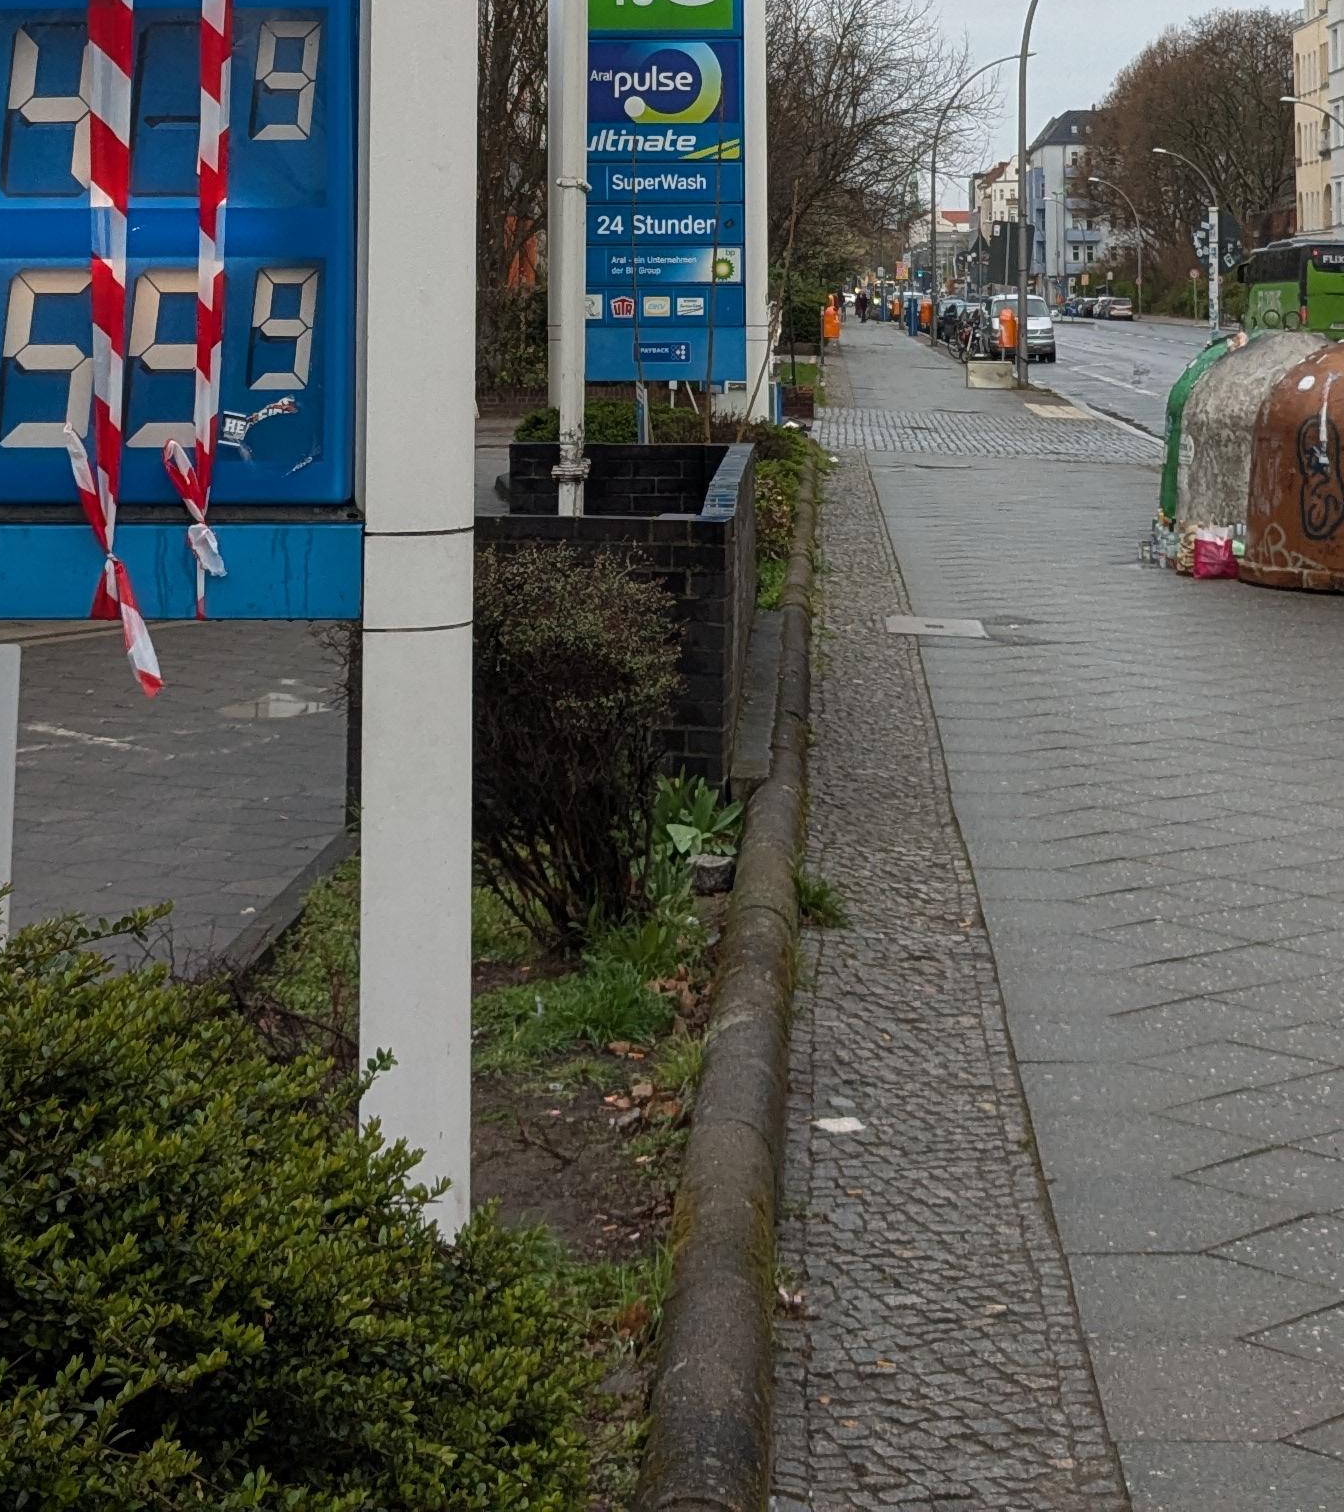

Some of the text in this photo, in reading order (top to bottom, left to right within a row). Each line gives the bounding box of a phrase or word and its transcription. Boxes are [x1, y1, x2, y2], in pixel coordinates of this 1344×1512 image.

[590, 65, 694, 99] Aral pulse
[612, 173, 707, 193] SuperWash
[596, 214, 716, 235] 24 Stunden
[611, 256, 627, 264] Aral
[638, 267, 661, 276] Group
